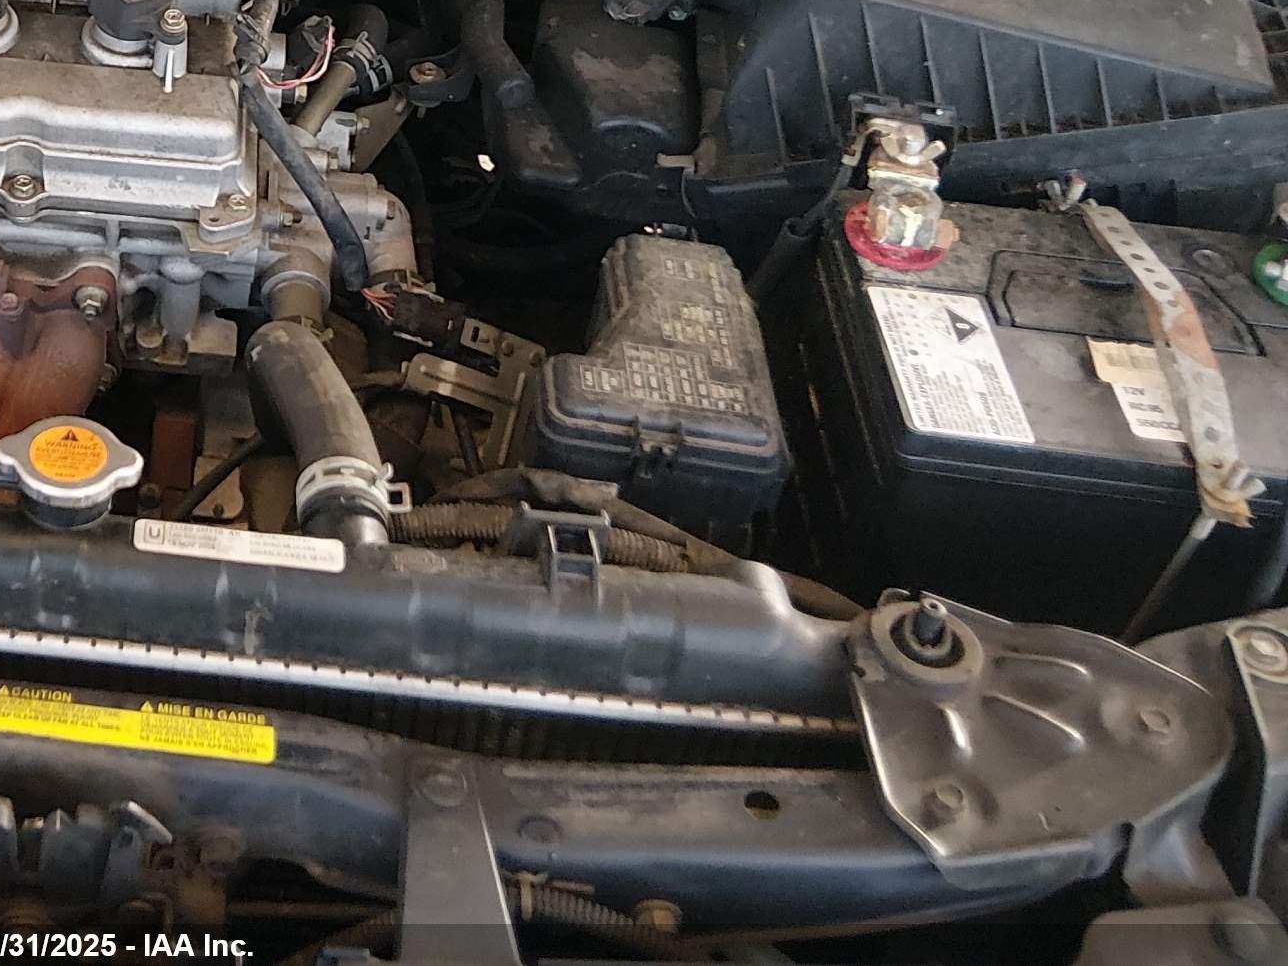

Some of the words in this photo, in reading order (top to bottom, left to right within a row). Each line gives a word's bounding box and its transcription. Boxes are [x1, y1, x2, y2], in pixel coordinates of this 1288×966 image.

[11, 686, 72, 702] CAUTION
[157, 702, 191, 716] MISE
[195, 707, 213, 719] EN
[217, 709, 266, 725] GARDE
